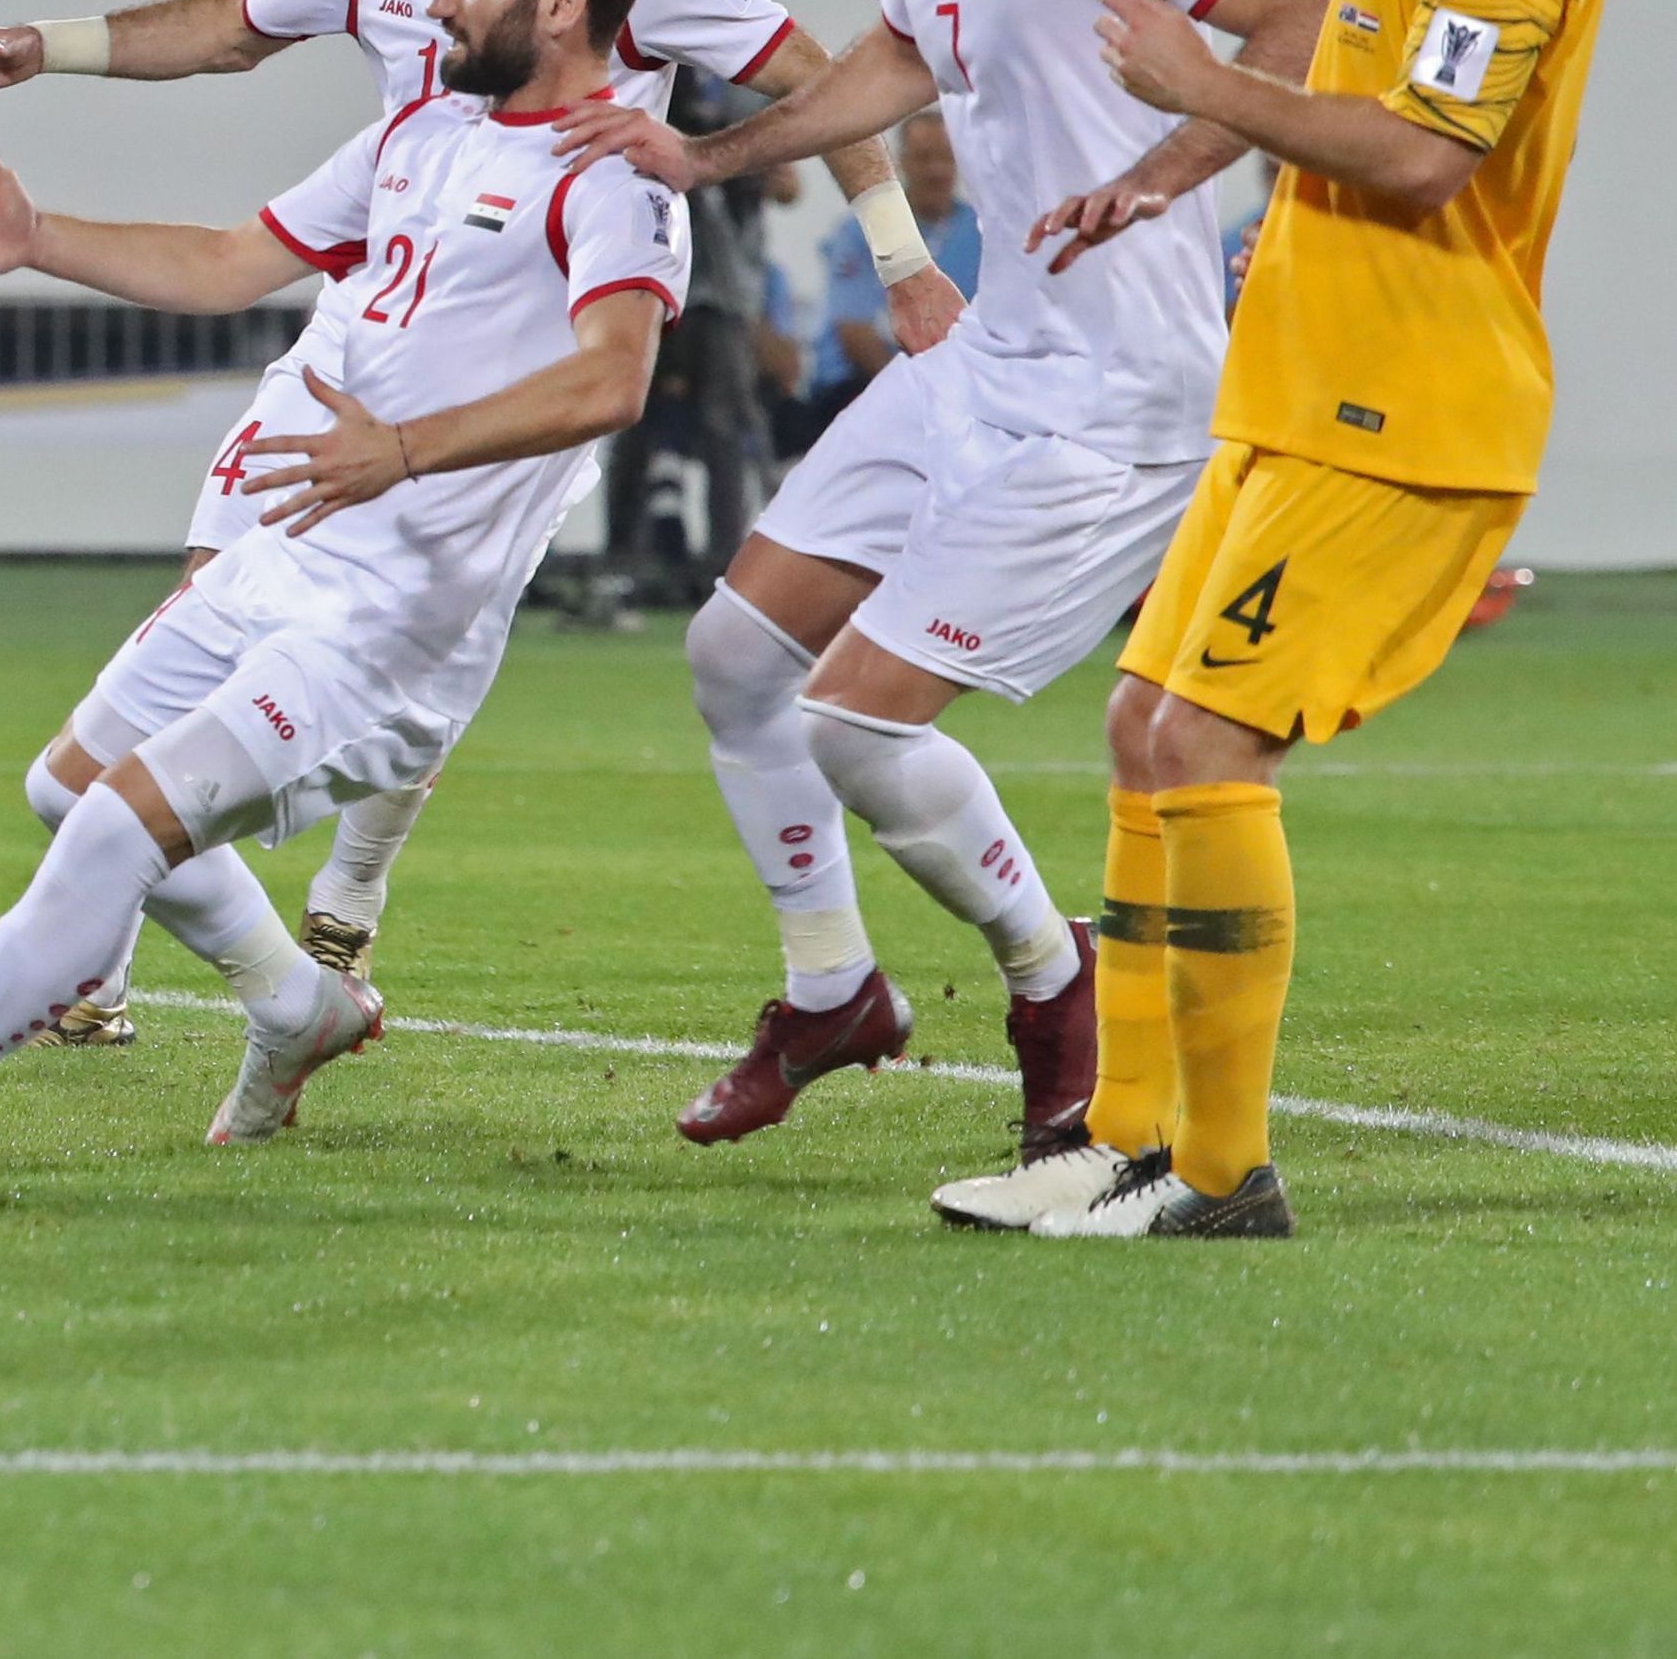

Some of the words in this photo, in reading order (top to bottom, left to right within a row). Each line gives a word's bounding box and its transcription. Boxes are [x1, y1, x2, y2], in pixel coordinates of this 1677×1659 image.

[936, 2, 974, 93] 7
[379, 174, 409, 192] JAO
[362, 234, 439, 329] 21
[211, 421, 262, 495] 4
[925, 618, 981, 652] JAKO
[1219, 554, 1289, 645] 4
[252, 694, 296, 741] JAKO
